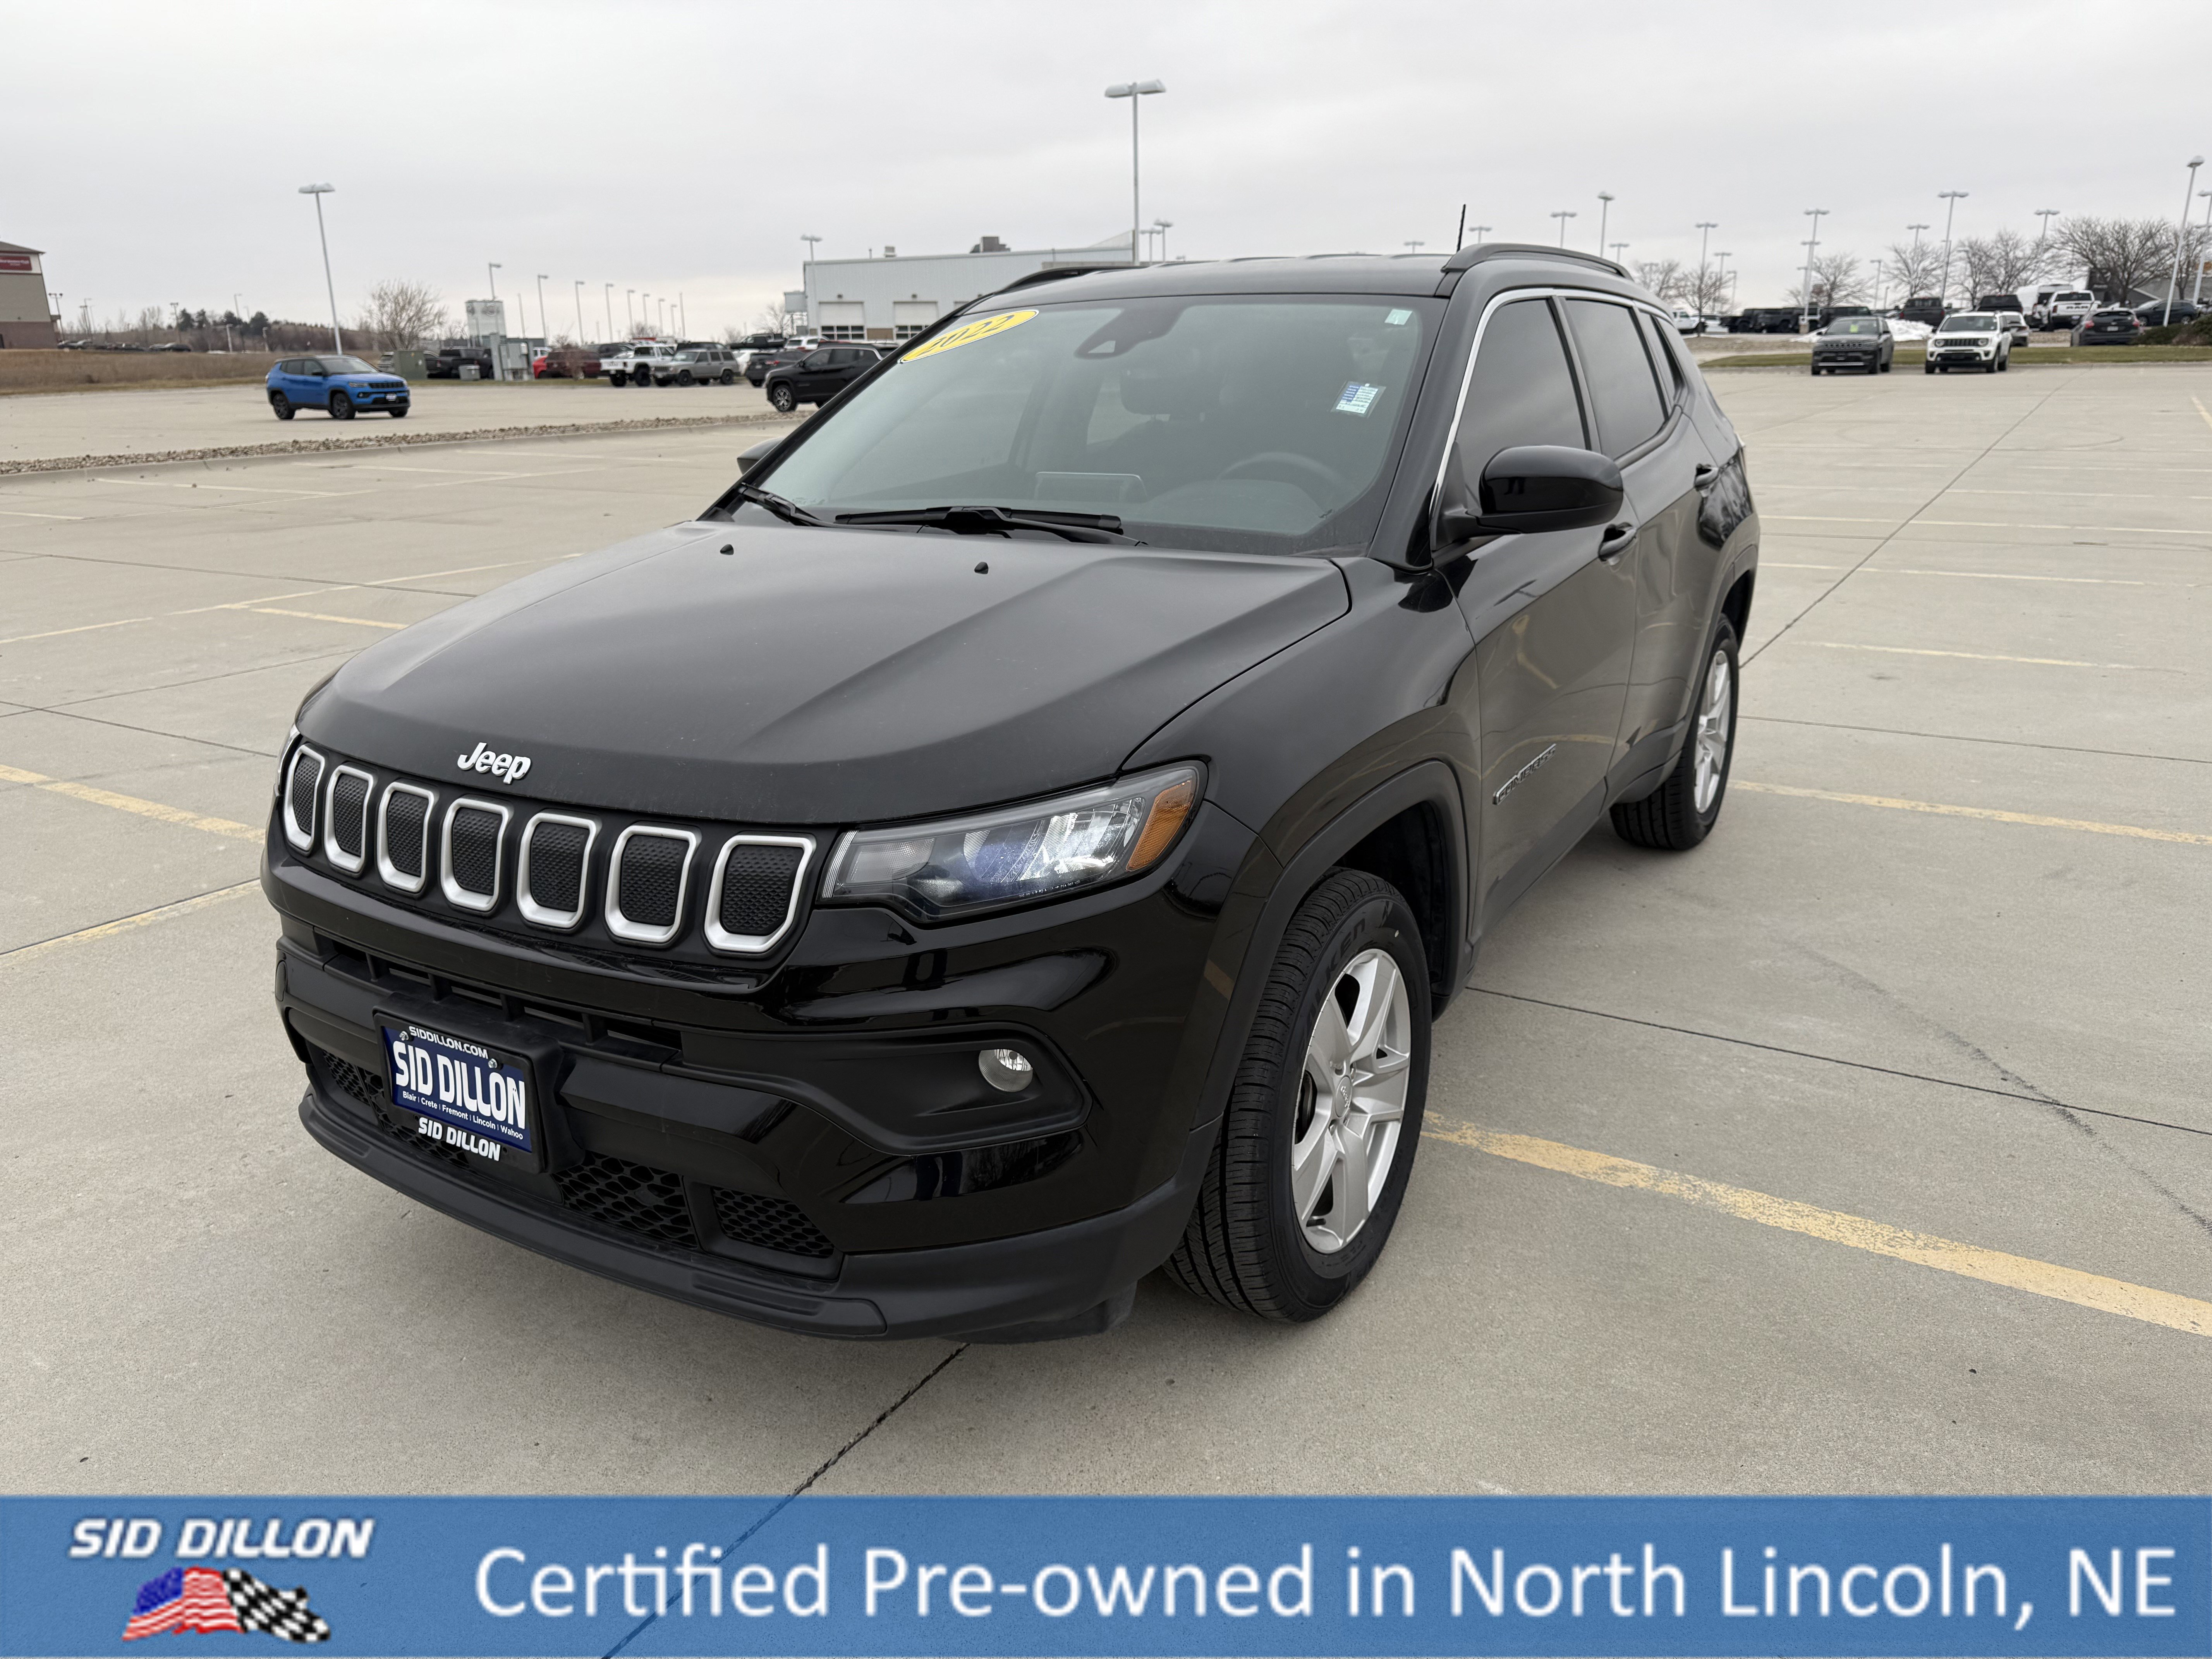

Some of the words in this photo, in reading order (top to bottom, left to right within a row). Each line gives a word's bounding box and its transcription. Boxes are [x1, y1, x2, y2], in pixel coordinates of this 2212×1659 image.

[915, 314, 1015, 357] 2022
[457, 742, 531, 785] Jeep
[409, 1026, 488, 1060] SIDDILLON.COM
[393, 1041, 433, 1096] SID
[436, 1054, 526, 1130] DILLON
[403, 1091, 417, 1102] Blair
[421, 1097, 438, 1109] Crete
[442, 1104, 468, 1120] Fremont
[473, 1115, 496, 1130] Lincoln
[500, 1125, 523, 1140] Wahoo
[418, 1117, 443, 1140] SID
[446, 1126, 501, 1161] DILLON
